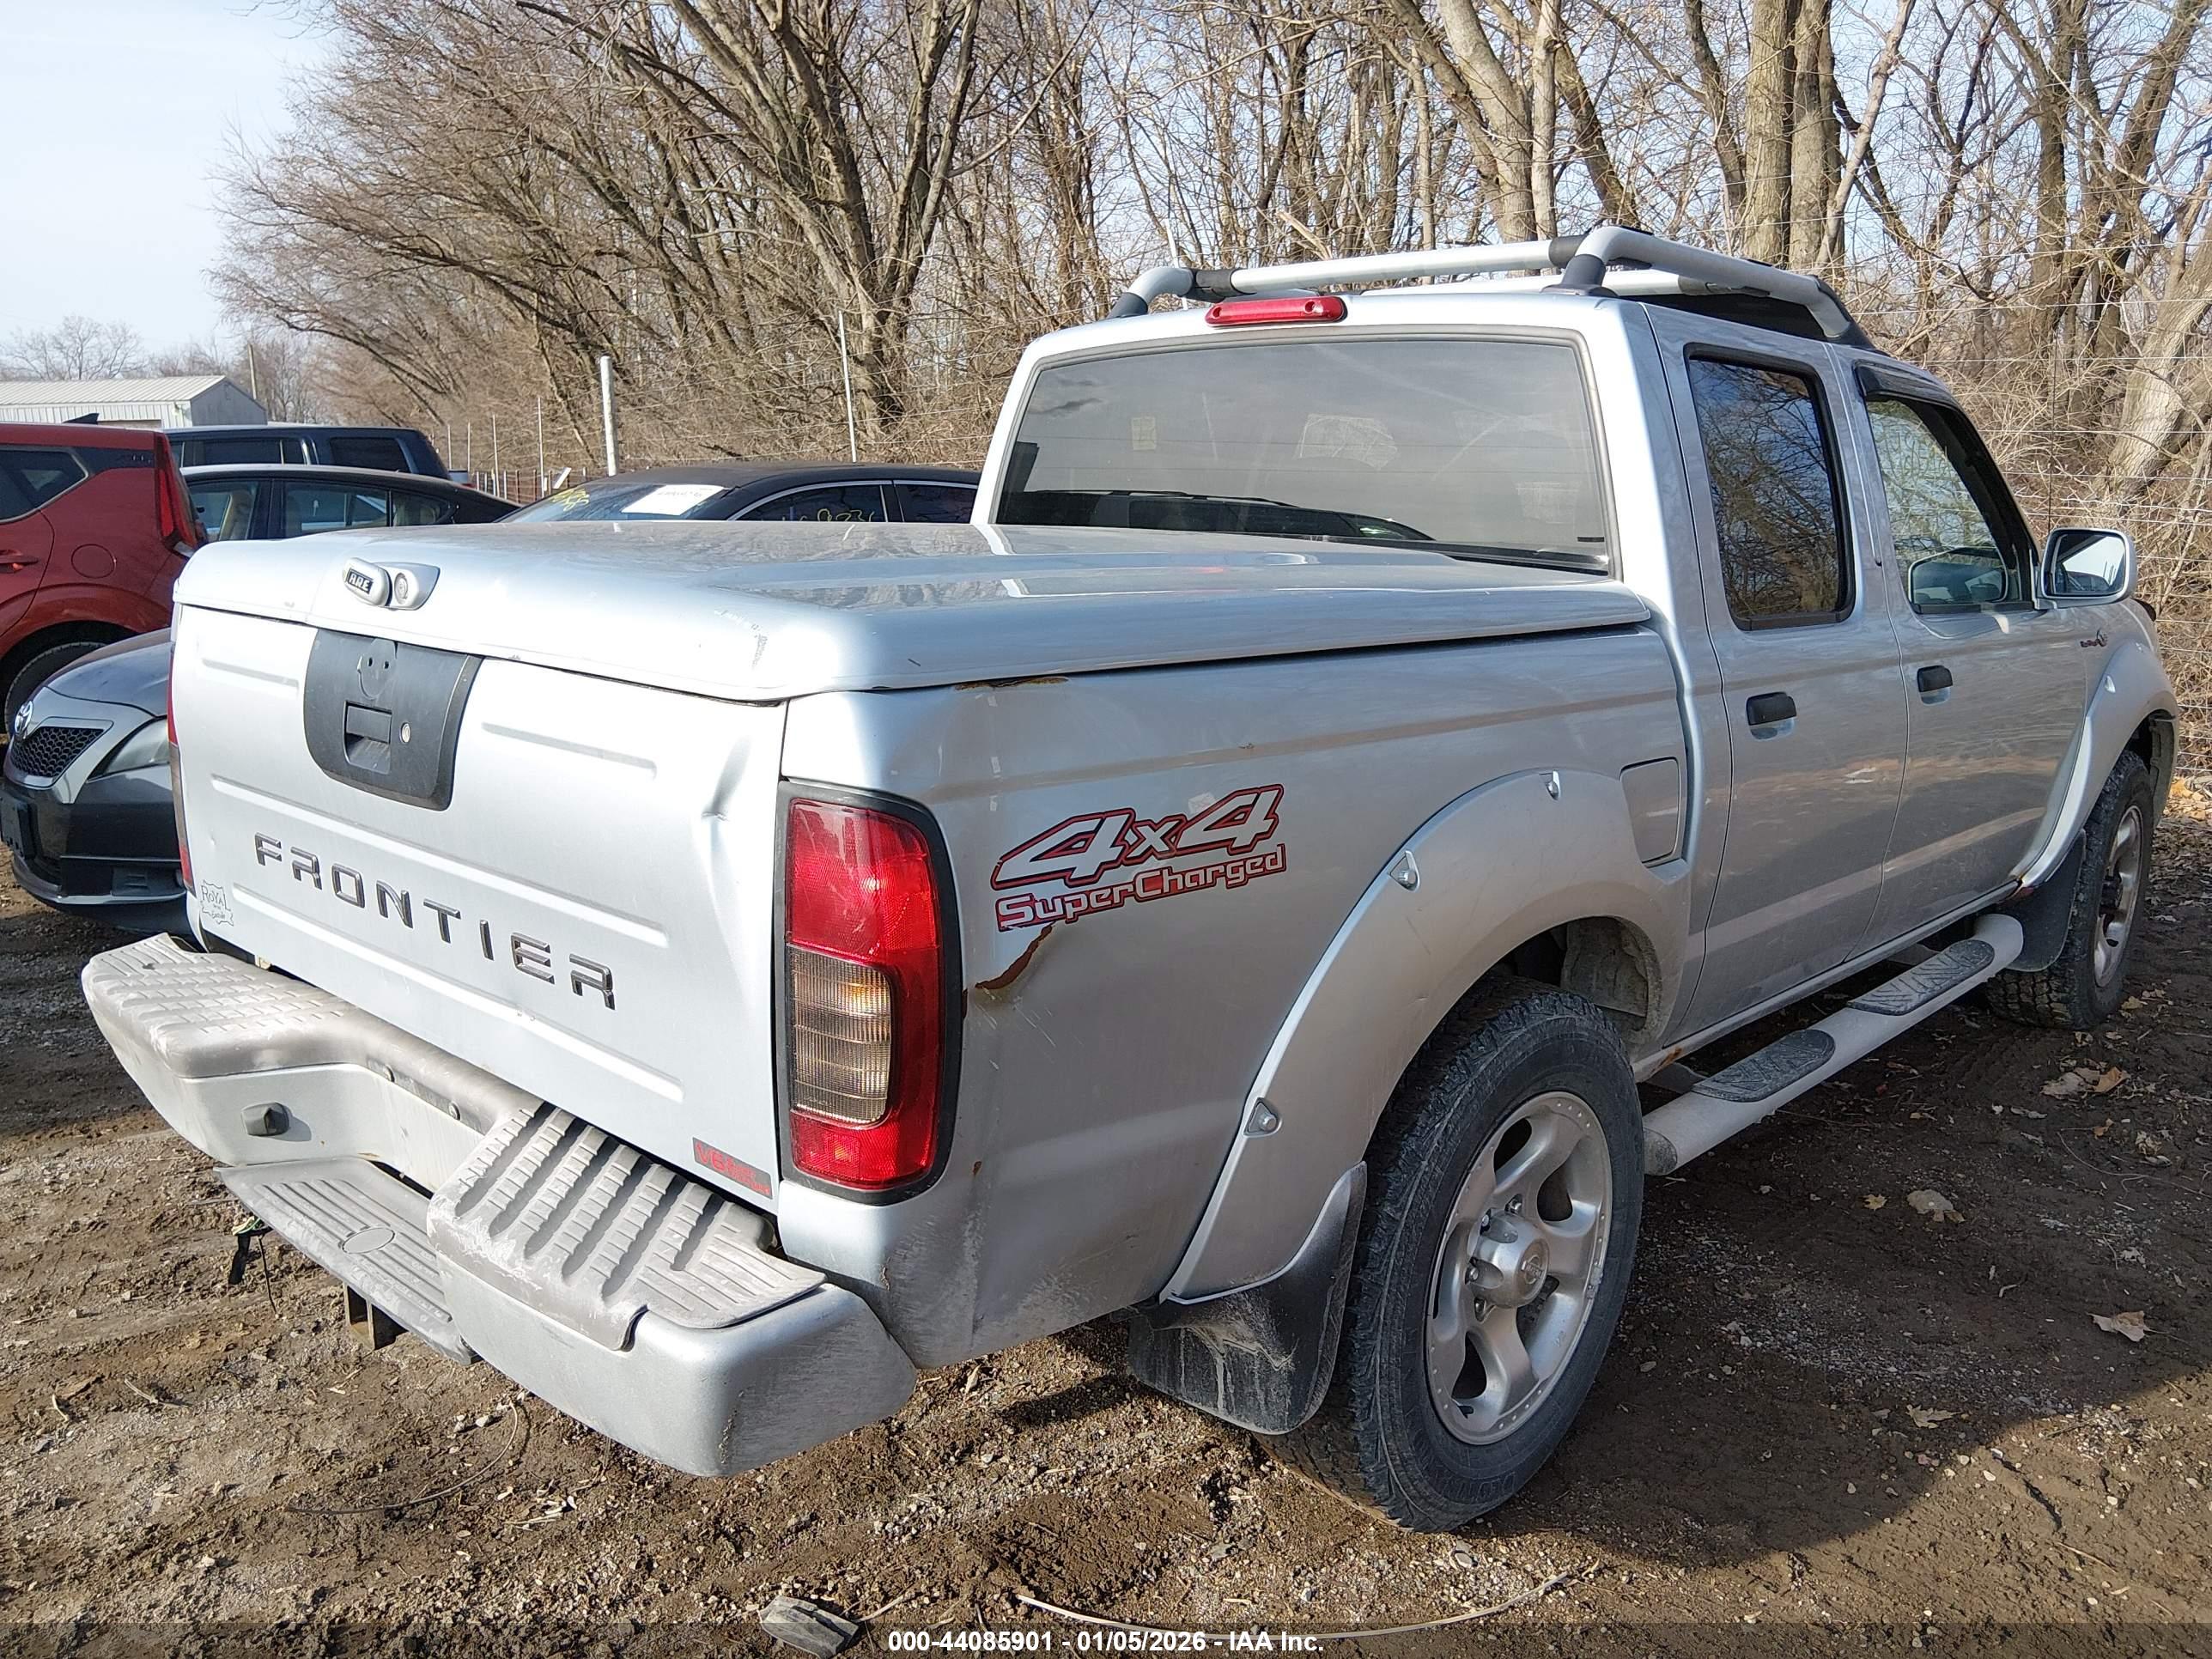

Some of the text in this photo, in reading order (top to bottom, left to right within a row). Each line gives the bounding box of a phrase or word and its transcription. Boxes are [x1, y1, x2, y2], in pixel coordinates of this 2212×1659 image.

[348, 571, 371, 592] ARE
[990, 783, 1285, 890] 4x4
[254, 832, 616, 1011] FRONTIER
[994, 842, 1287, 933] SuperCharged
